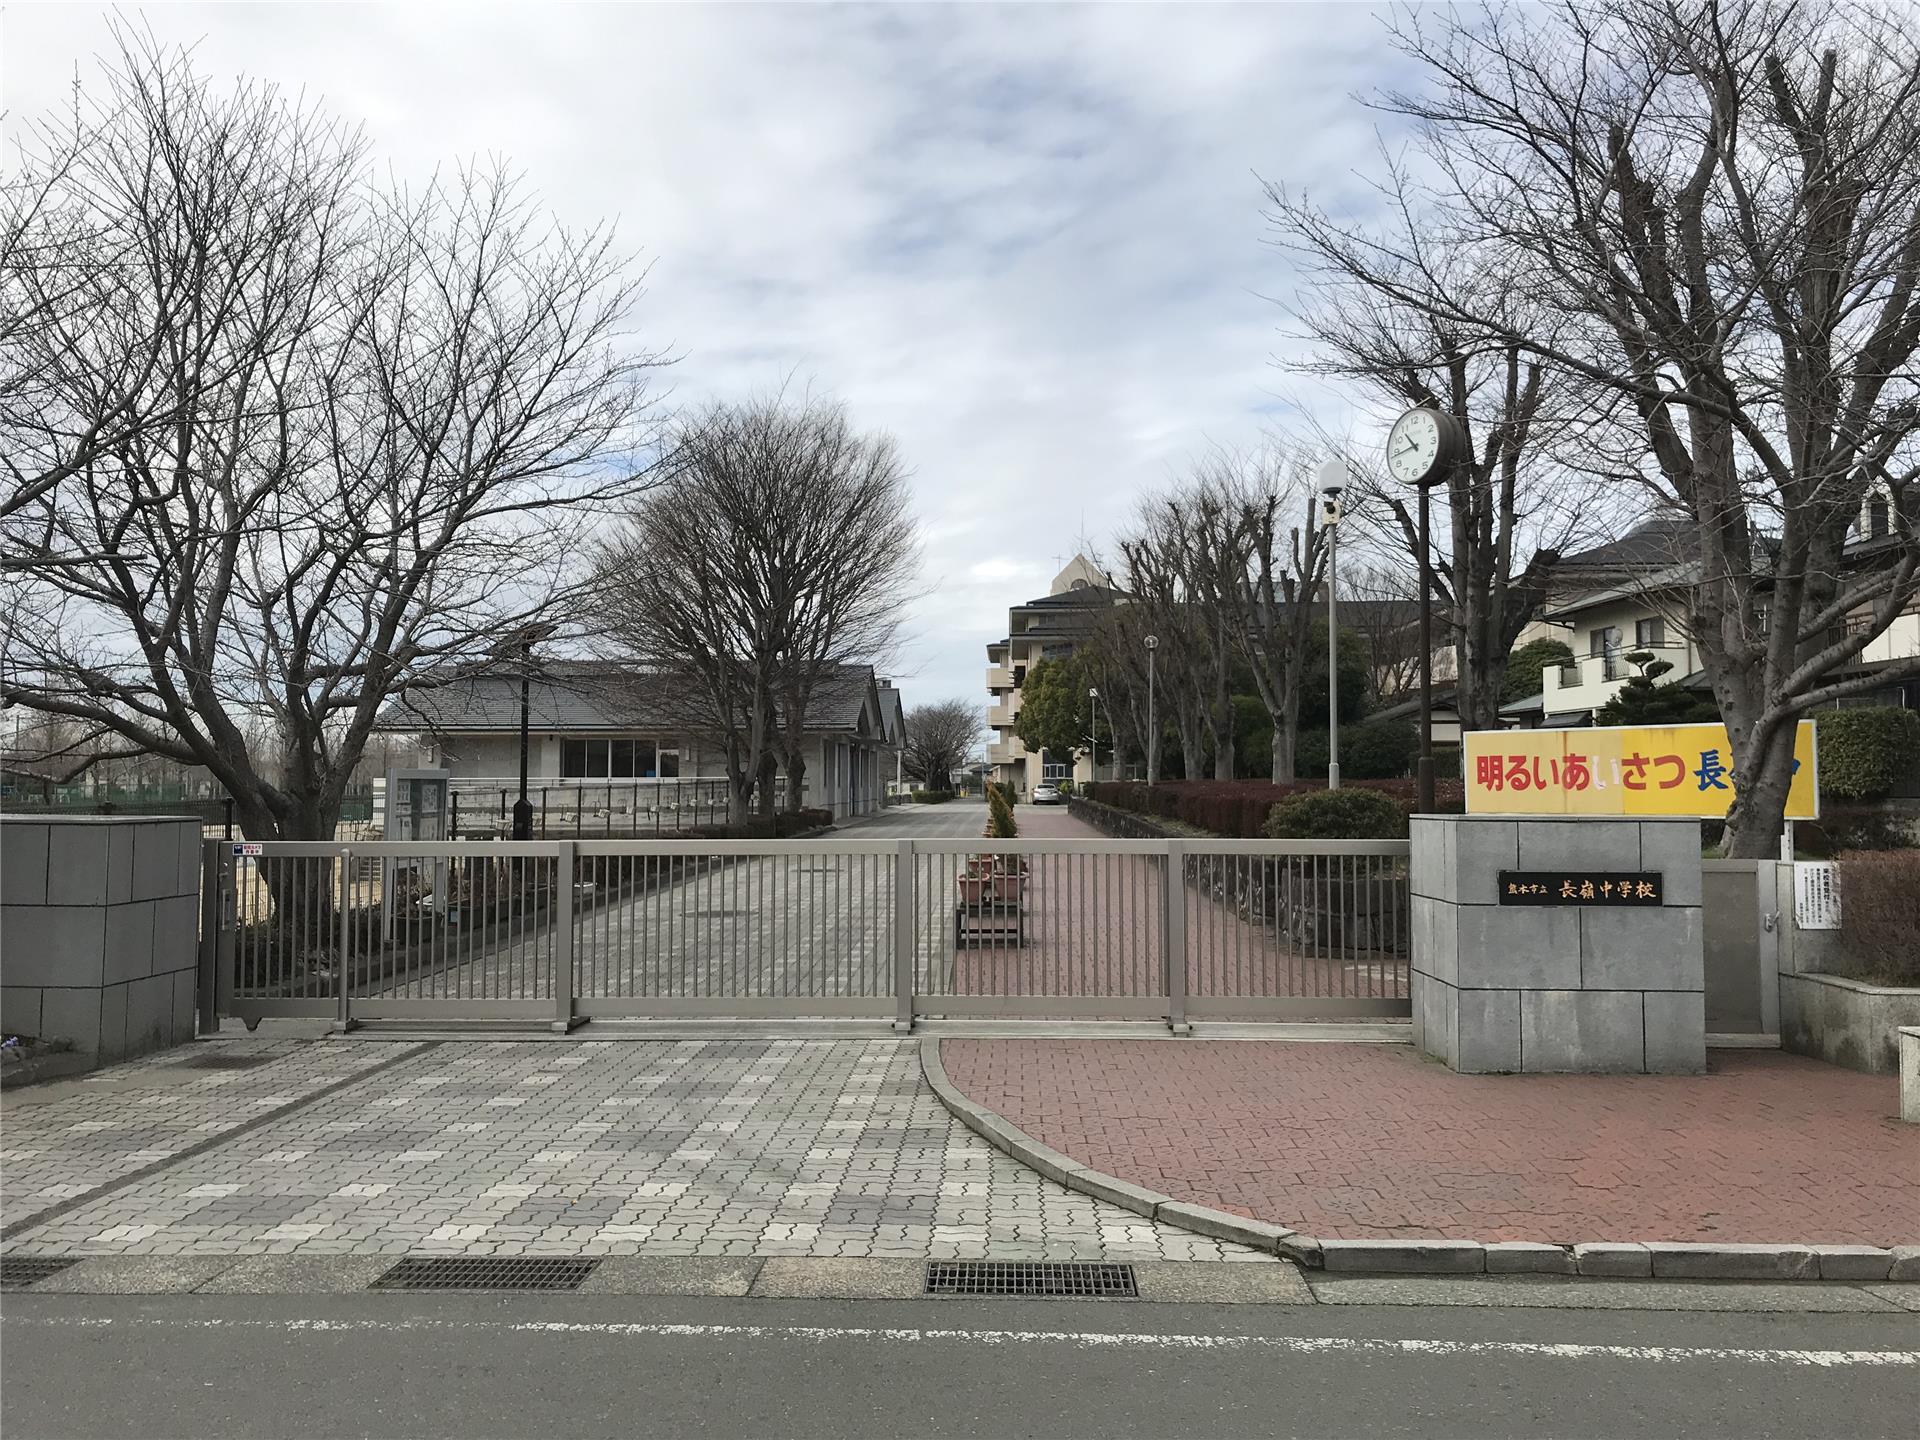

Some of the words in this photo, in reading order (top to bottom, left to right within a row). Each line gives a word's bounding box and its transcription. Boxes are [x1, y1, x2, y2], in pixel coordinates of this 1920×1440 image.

[1476, 752, 1685, 791] 明るいあいさつ
[1558, 879, 1657, 899] 長嶺中学校
